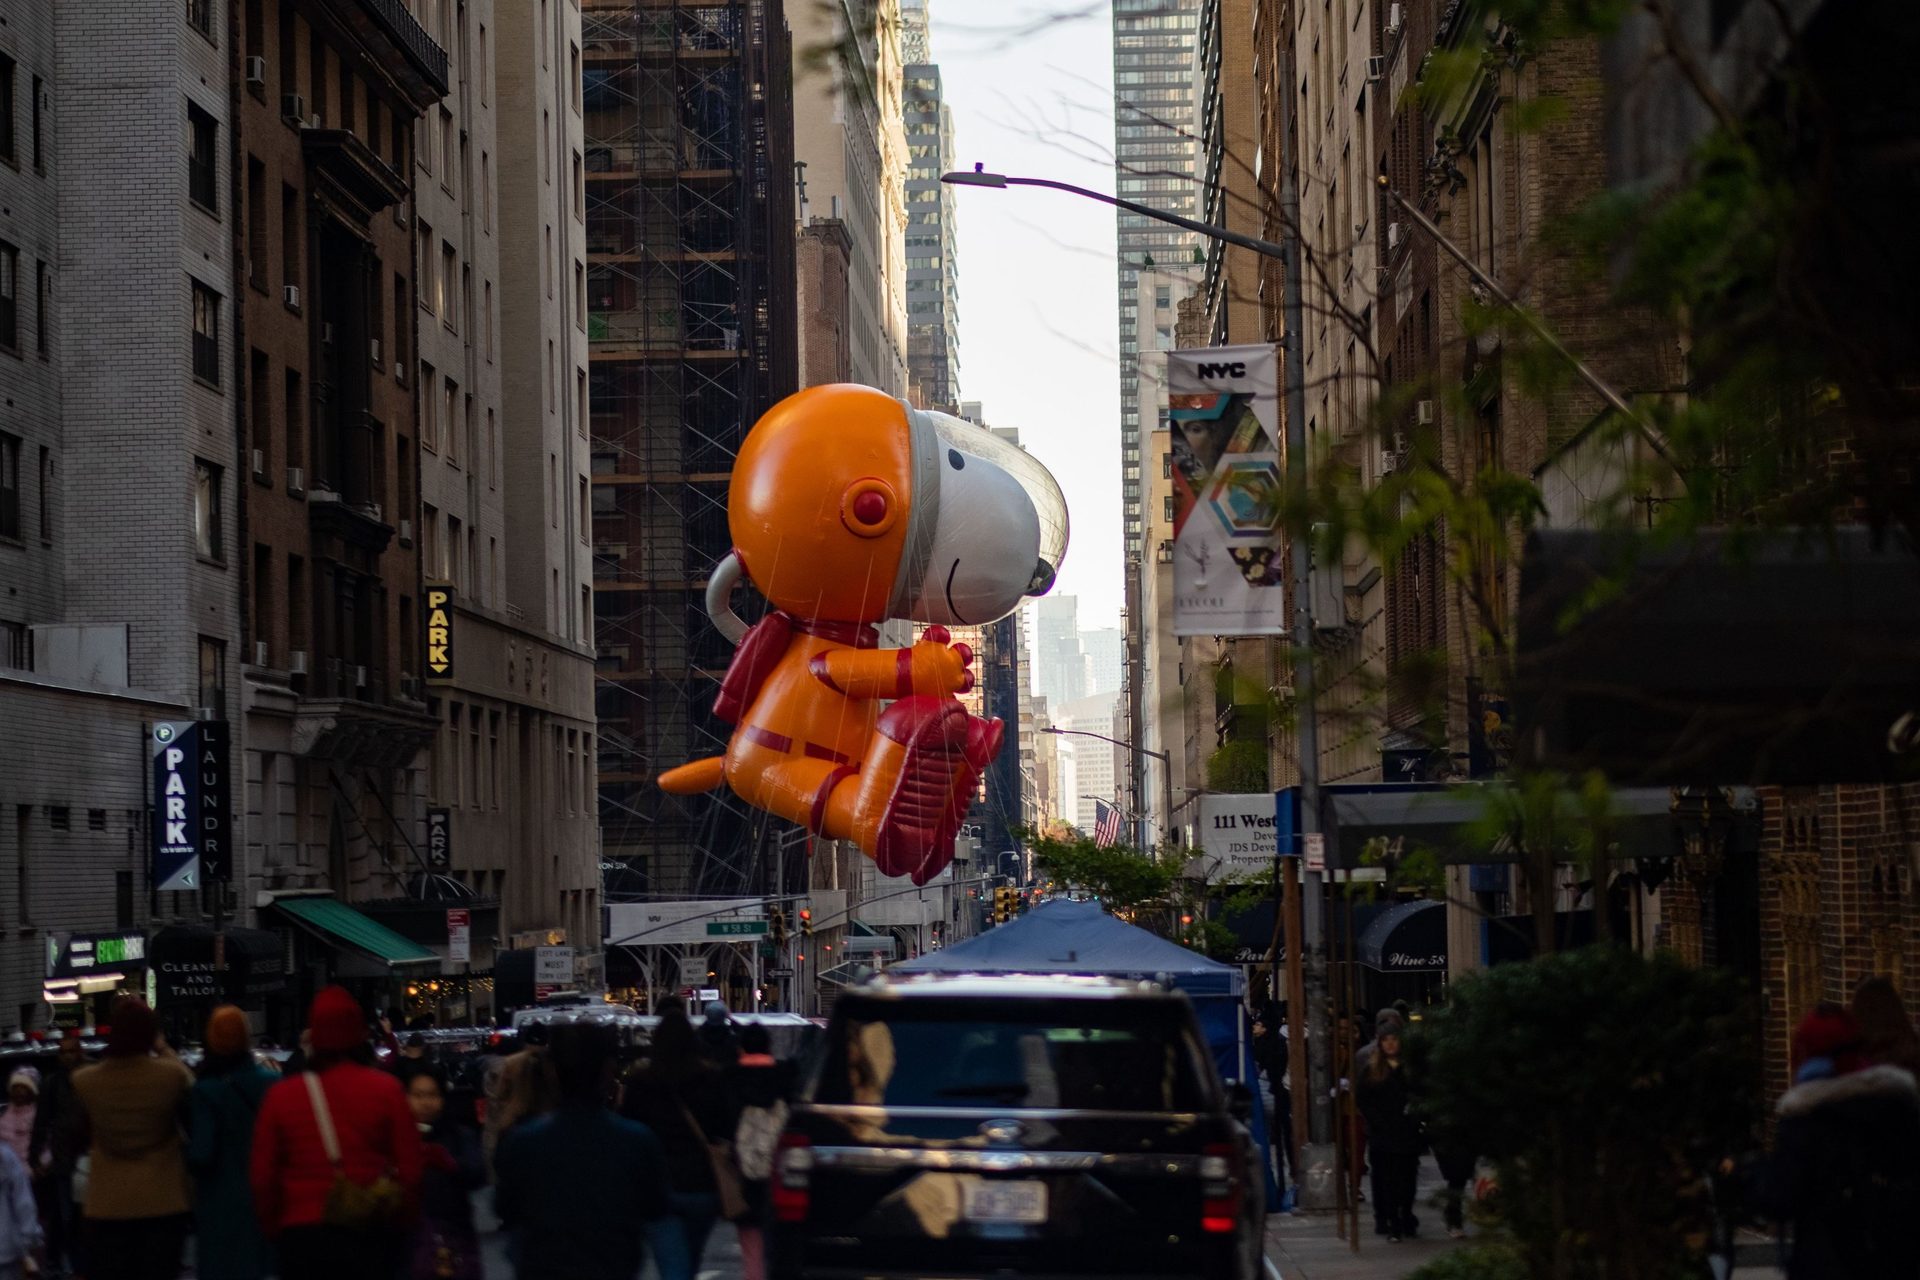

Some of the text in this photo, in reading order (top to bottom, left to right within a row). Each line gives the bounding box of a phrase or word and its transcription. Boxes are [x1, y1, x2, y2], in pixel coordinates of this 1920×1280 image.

[1198, 362, 1246, 379] NYC
[429, 591, 449, 663] PARK
[165, 748, 188, 845] PARK
[203, 729, 219, 875] LAUNDRY
[1214, 814, 1278, 829] 111 West
[430, 814, 447, 860] PARK
[1229, 842, 1249, 853] JDS
[722, 925, 728, 933] W
[161, 961, 231, 973] CLEANES
[1427, 954, 1446, 966] 58
[185, 975, 215, 984] AND
